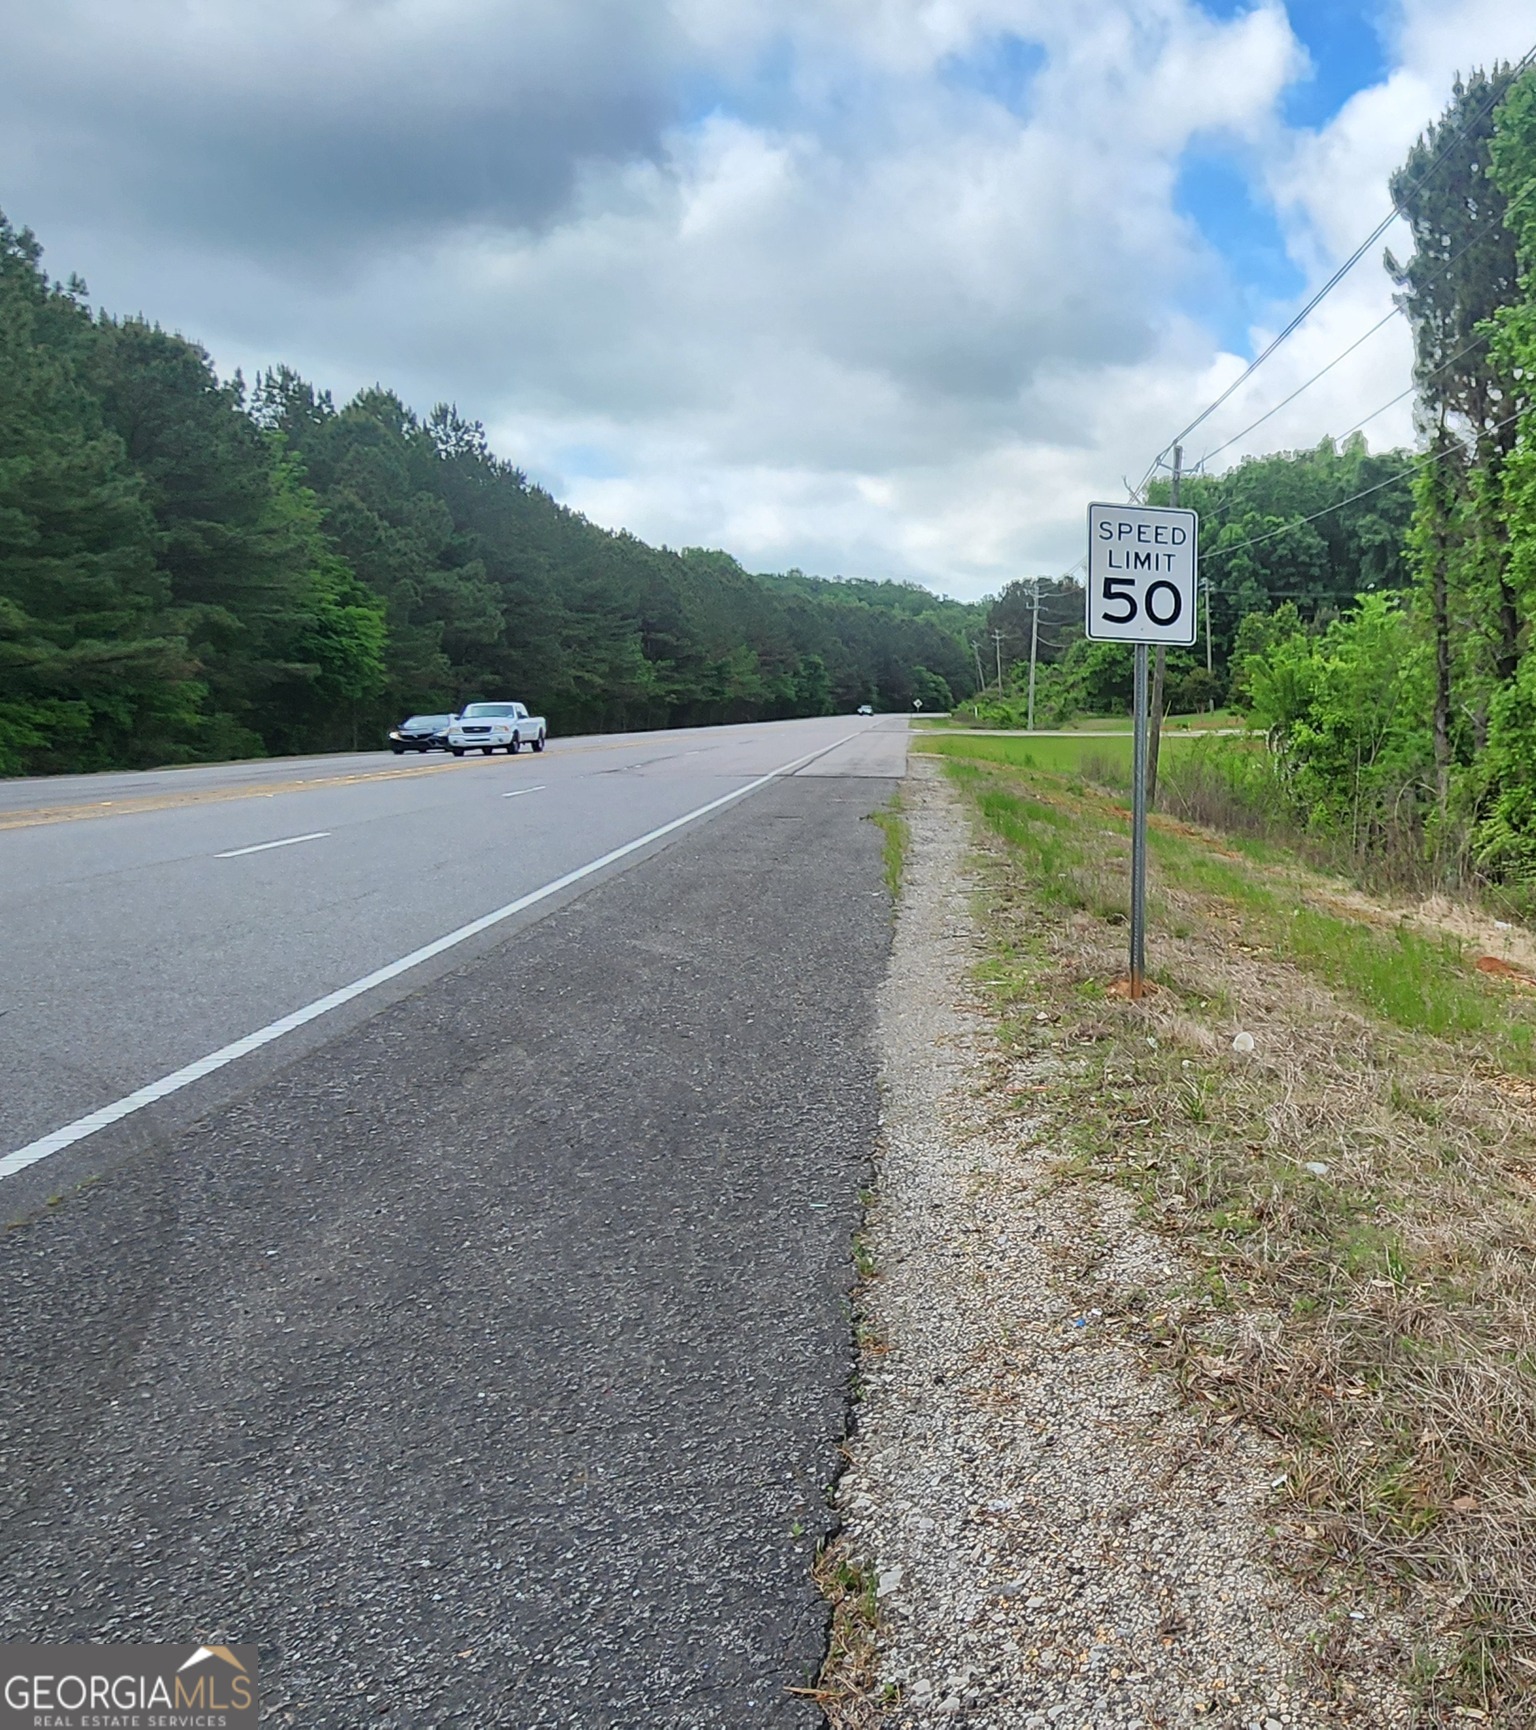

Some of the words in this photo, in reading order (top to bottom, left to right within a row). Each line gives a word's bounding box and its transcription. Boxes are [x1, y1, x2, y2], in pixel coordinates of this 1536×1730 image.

[1099, 521, 1187, 546] SPEED
[1108, 549, 1177, 572] LIMIT
[1101, 577, 1182, 627] 50
